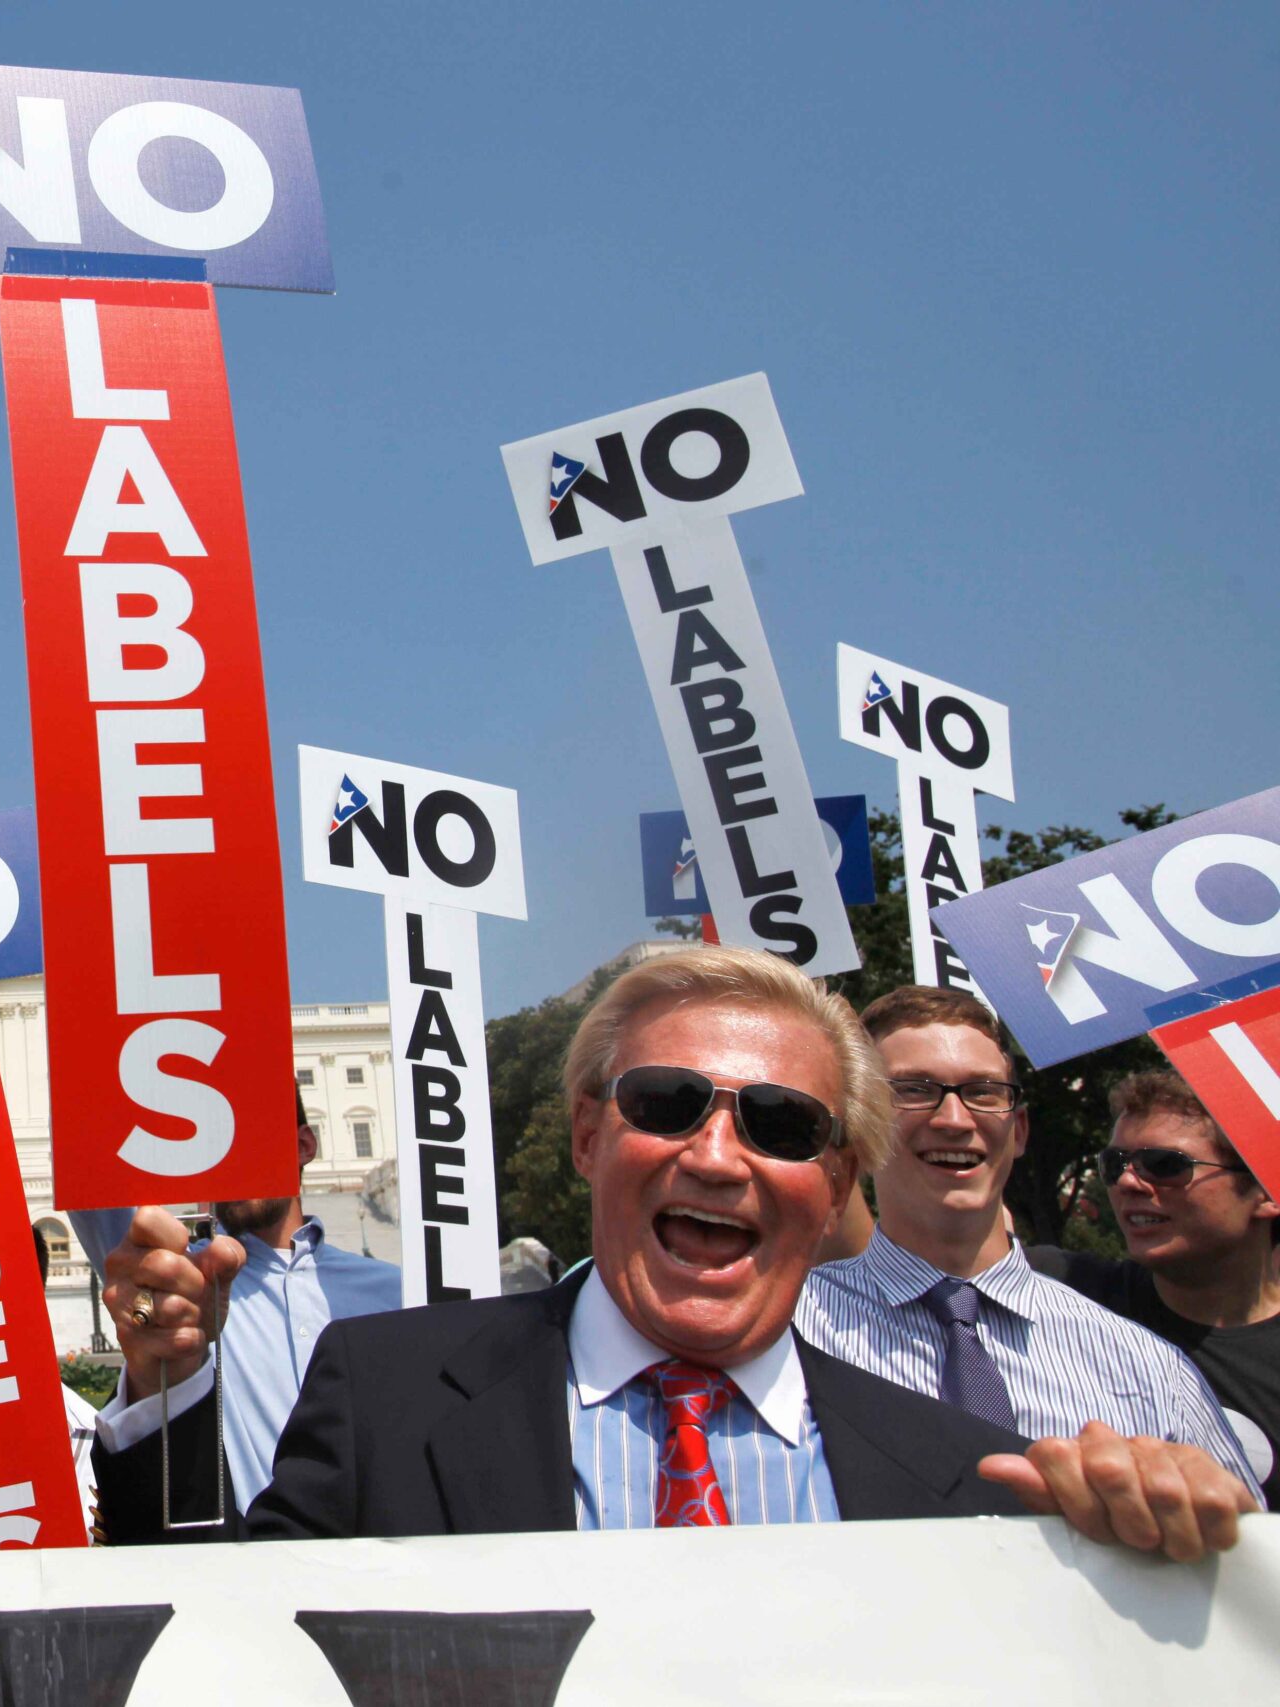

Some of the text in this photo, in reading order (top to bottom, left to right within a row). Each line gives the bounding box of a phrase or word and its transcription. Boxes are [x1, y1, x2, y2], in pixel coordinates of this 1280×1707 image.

[549, 407, 750, 541] NO
[60, 298, 236, 1177] LABELS
[643, 545, 818, 968] LABELS
[862, 672, 990, 770] NO
[328, 774, 496, 888] NO
[1042, 833, 1280, 1025] NO
